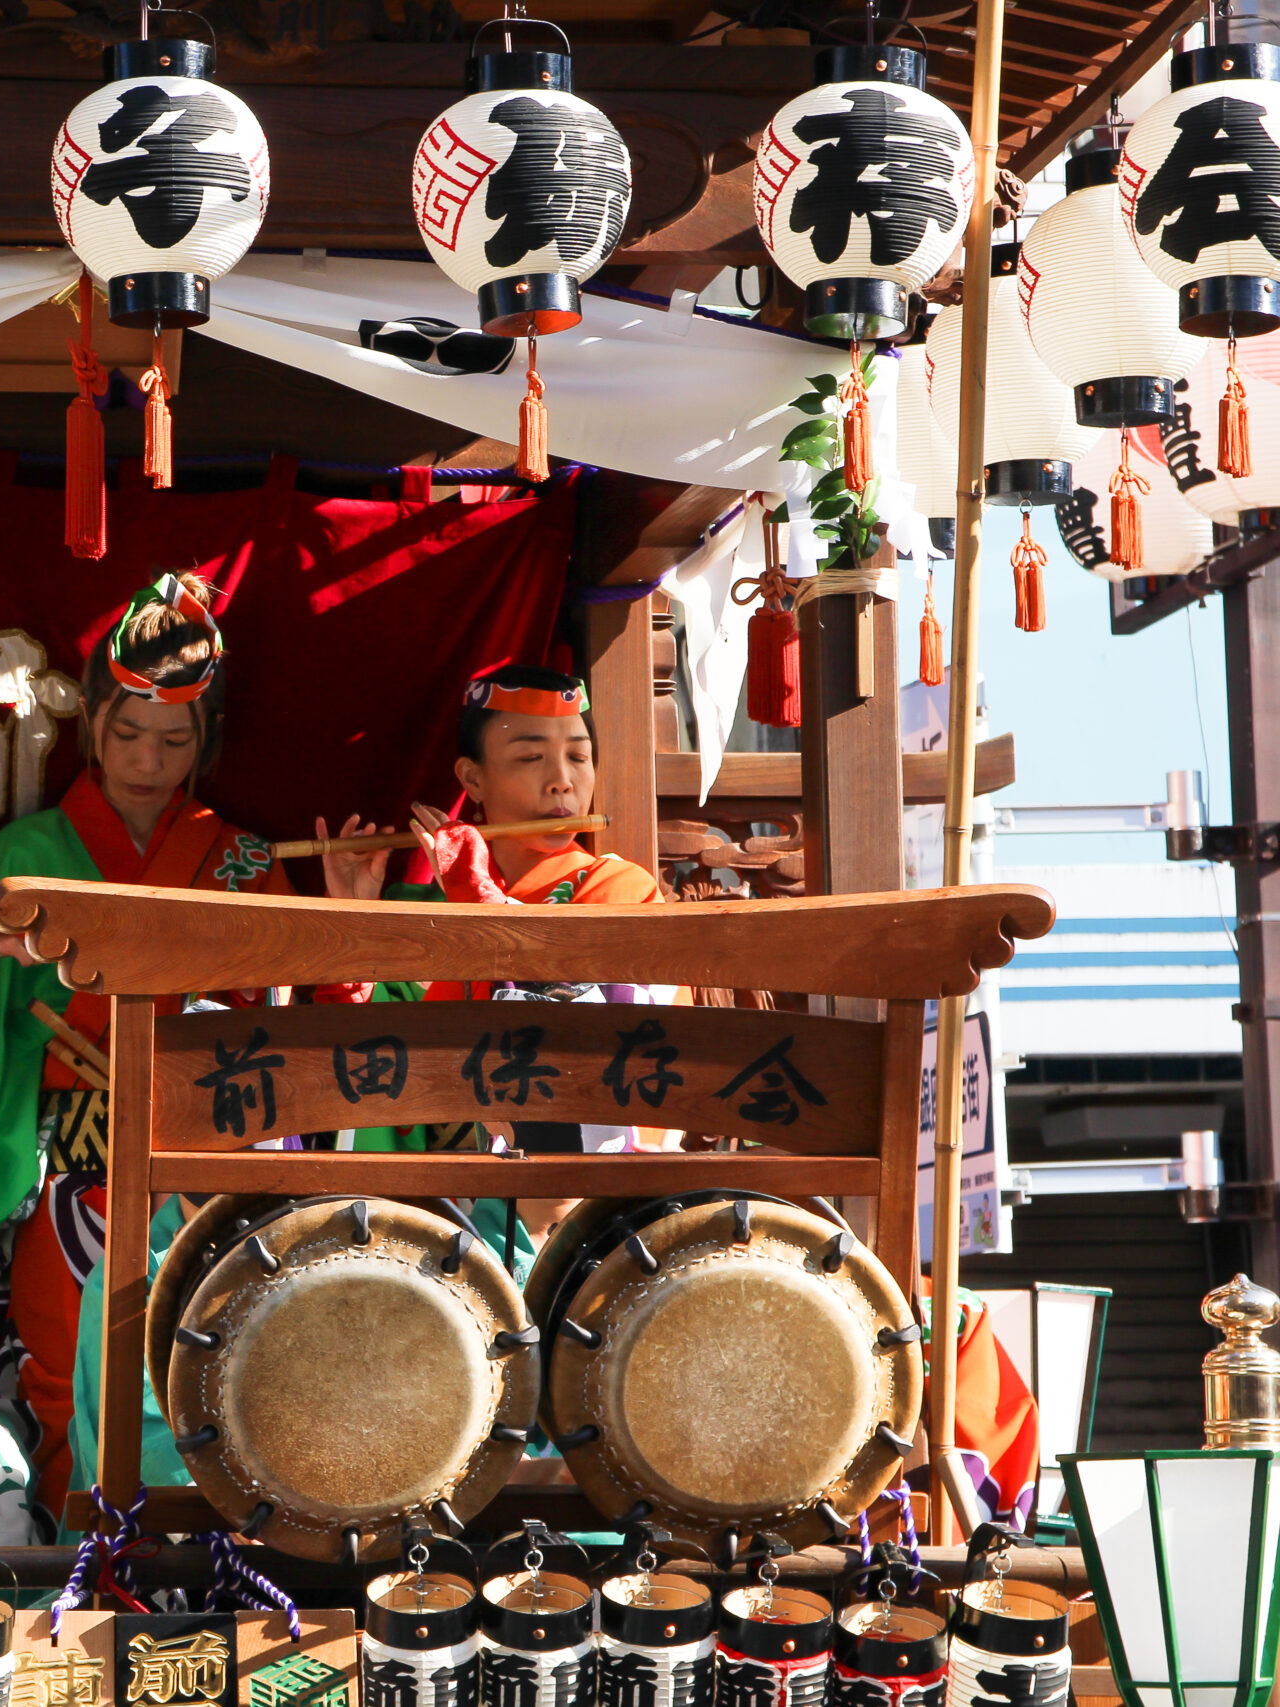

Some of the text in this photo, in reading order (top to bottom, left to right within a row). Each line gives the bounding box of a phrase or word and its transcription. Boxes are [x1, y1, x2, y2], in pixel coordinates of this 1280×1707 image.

[193, 1018, 829, 1138] 前田保存会
